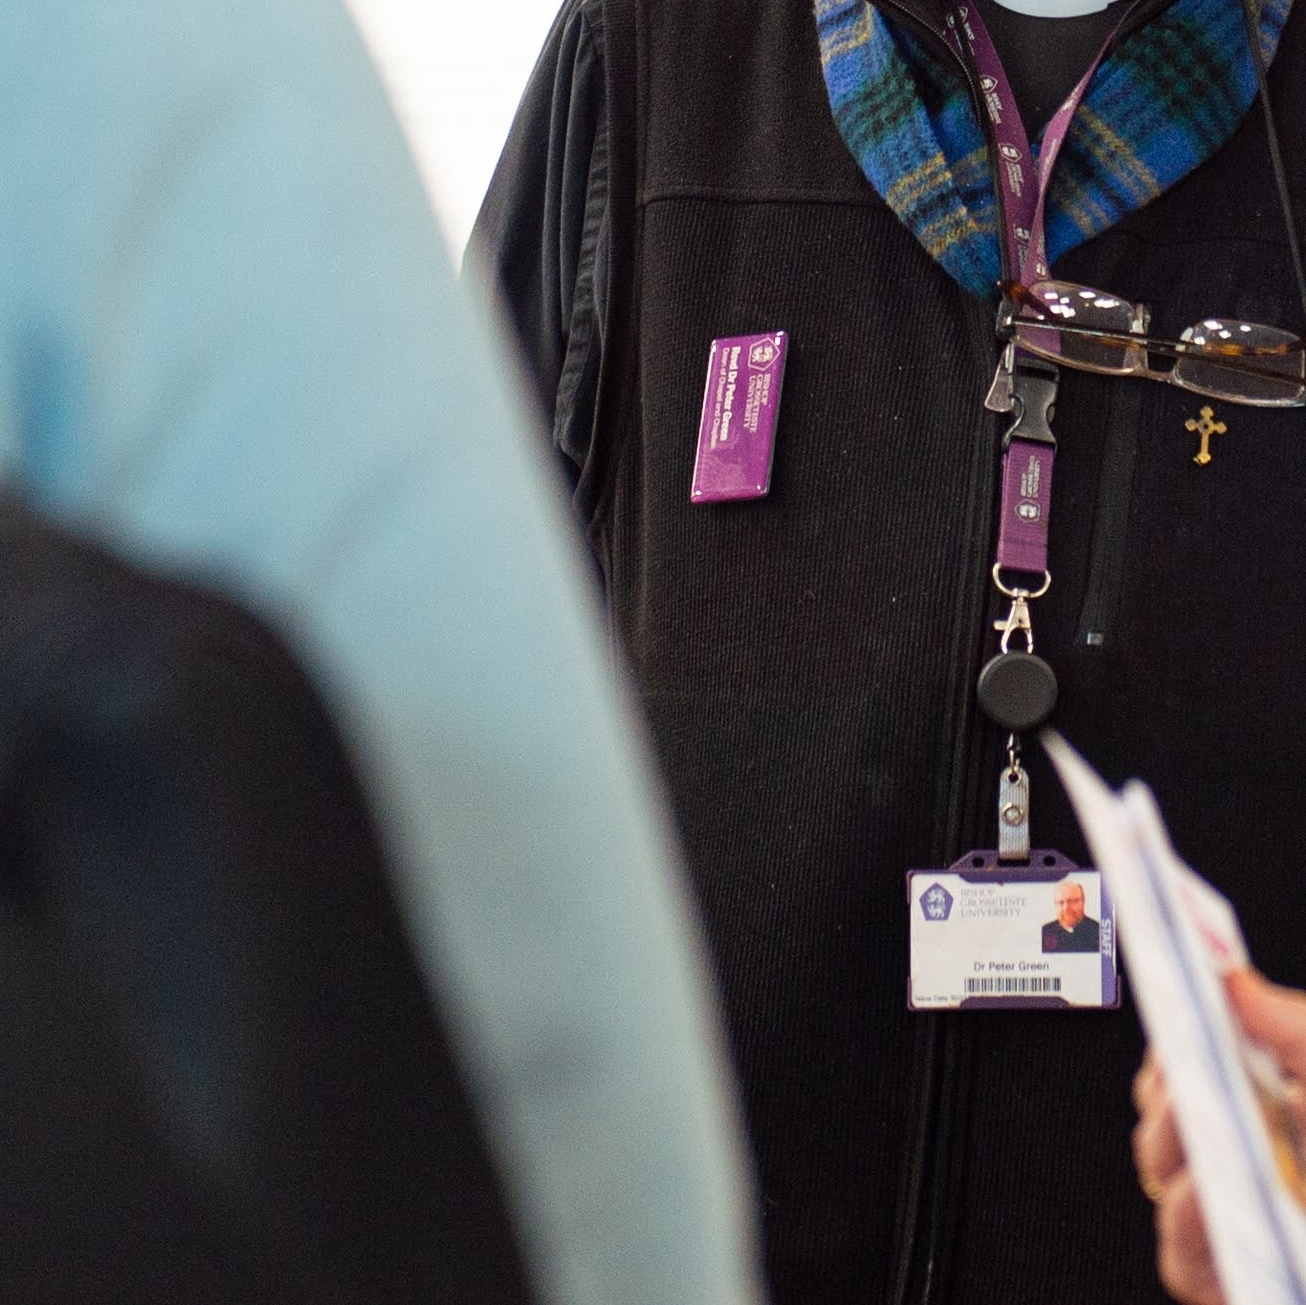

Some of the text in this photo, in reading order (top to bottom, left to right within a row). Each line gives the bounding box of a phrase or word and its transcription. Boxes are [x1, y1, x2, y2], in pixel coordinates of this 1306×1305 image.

[728, 371, 737, 383] Dr
[724, 384, 736, 410] Peter
[720, 411, 732, 441] Green
[960, 908, 1022, 918] UNIVERSITY
[1101, 918, 1112, 958] STAFF
[973, 961, 1050, 971] Dr Peter Green
